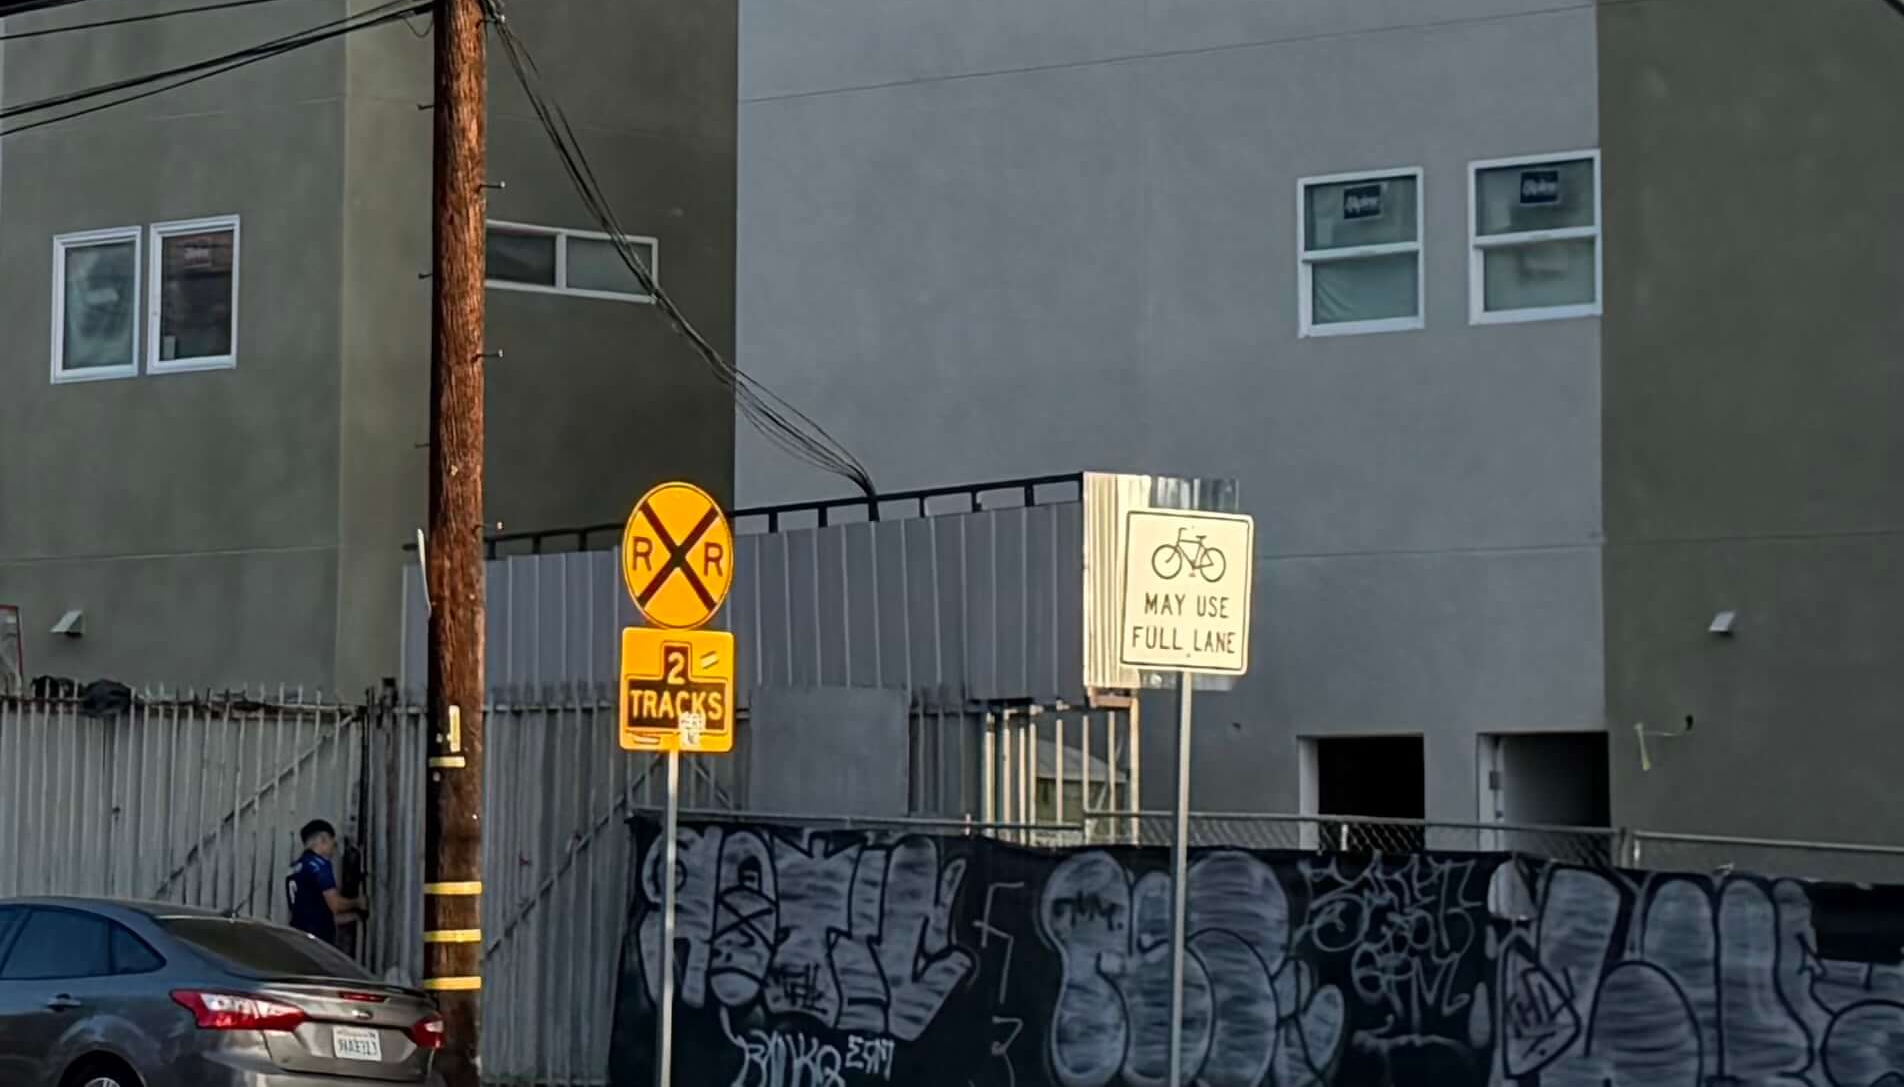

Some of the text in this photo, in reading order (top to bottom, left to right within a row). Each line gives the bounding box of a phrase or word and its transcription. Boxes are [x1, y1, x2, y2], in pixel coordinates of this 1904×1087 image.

[1143, 592, 1230, 619] MAY USE
[1131, 625, 1237, 655] FULL LANE
[666, 651, 686, 685] 2
[629, 689, 723, 721] TRACKS
